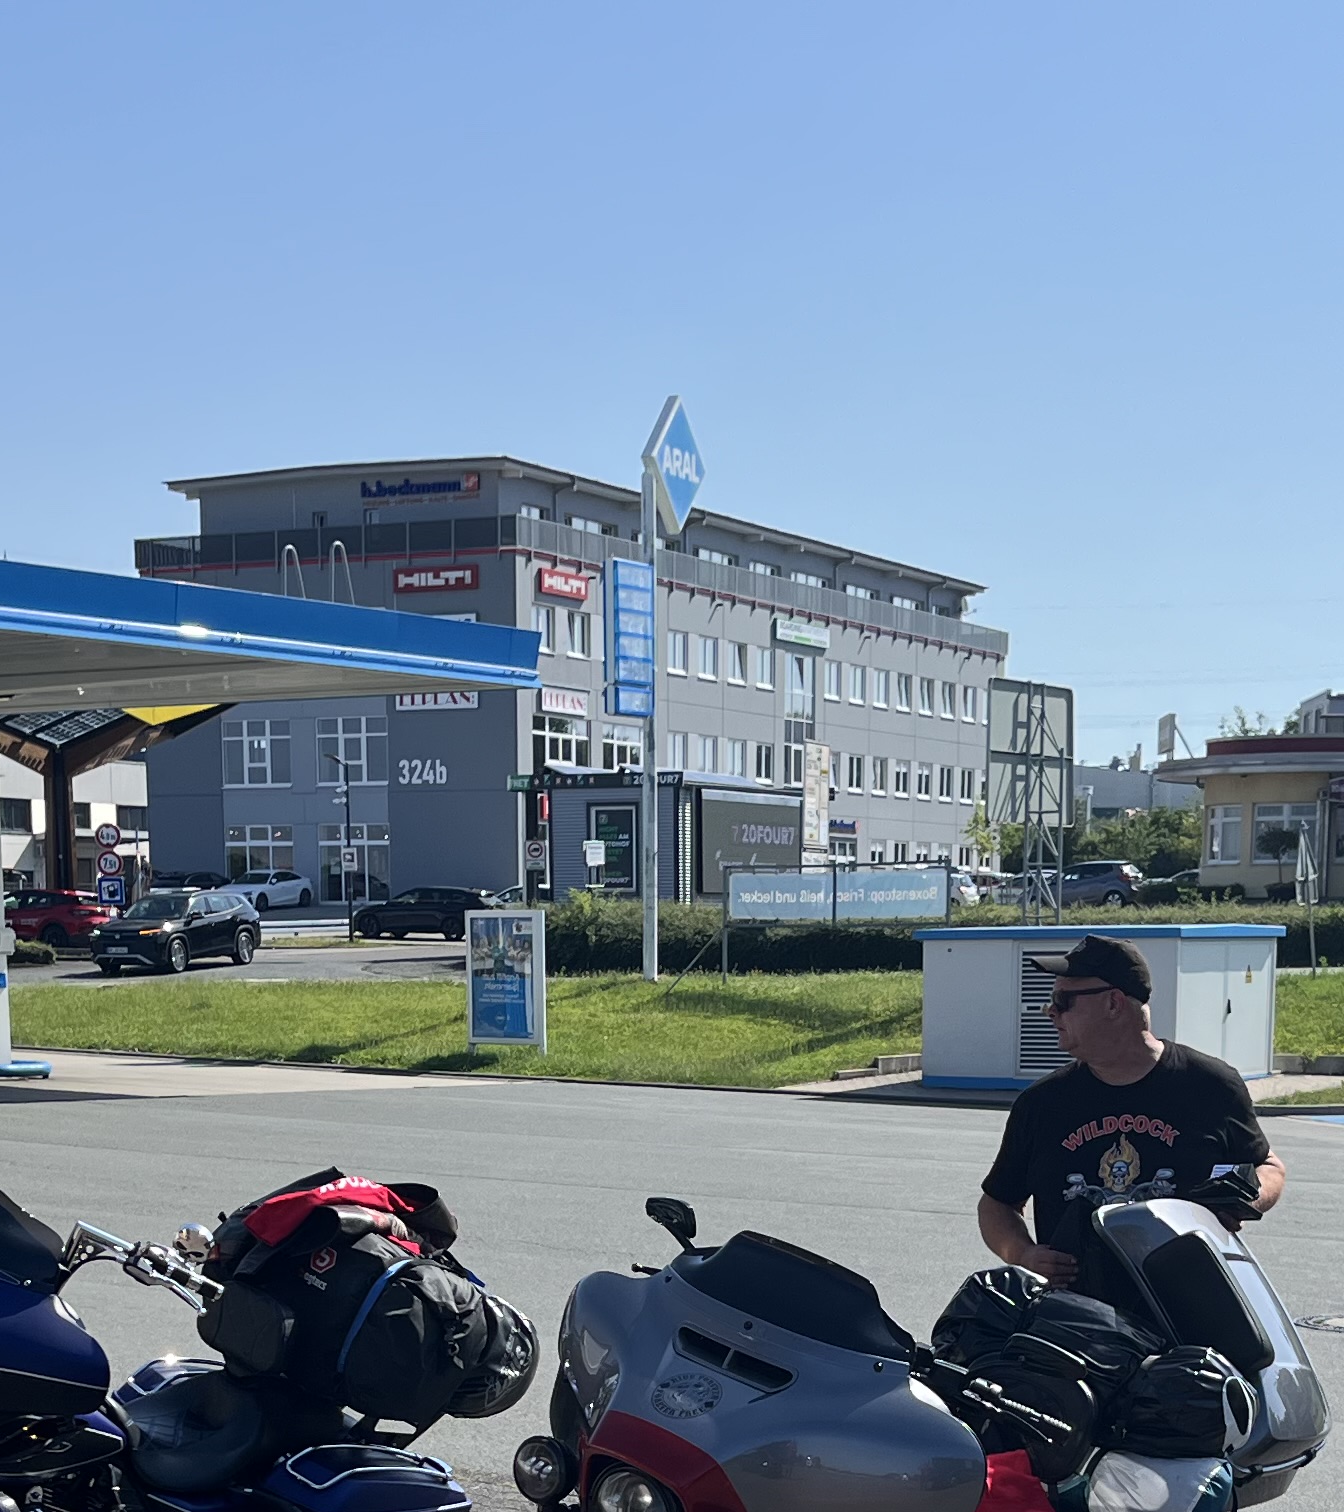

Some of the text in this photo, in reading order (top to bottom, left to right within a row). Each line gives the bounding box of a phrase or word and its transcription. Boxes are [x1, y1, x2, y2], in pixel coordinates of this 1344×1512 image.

[662, 444, 700, 484] ARAL
[397, 569, 472, 588] HILTI
[543, 572, 586, 595] HILTI
[398, 758, 448, 785] 324b
[633, 773, 679, 785] 20UR7
[741, 823, 795, 846] 20FOUR7
[1061, 1114, 1181, 1152] WILDCOCK
